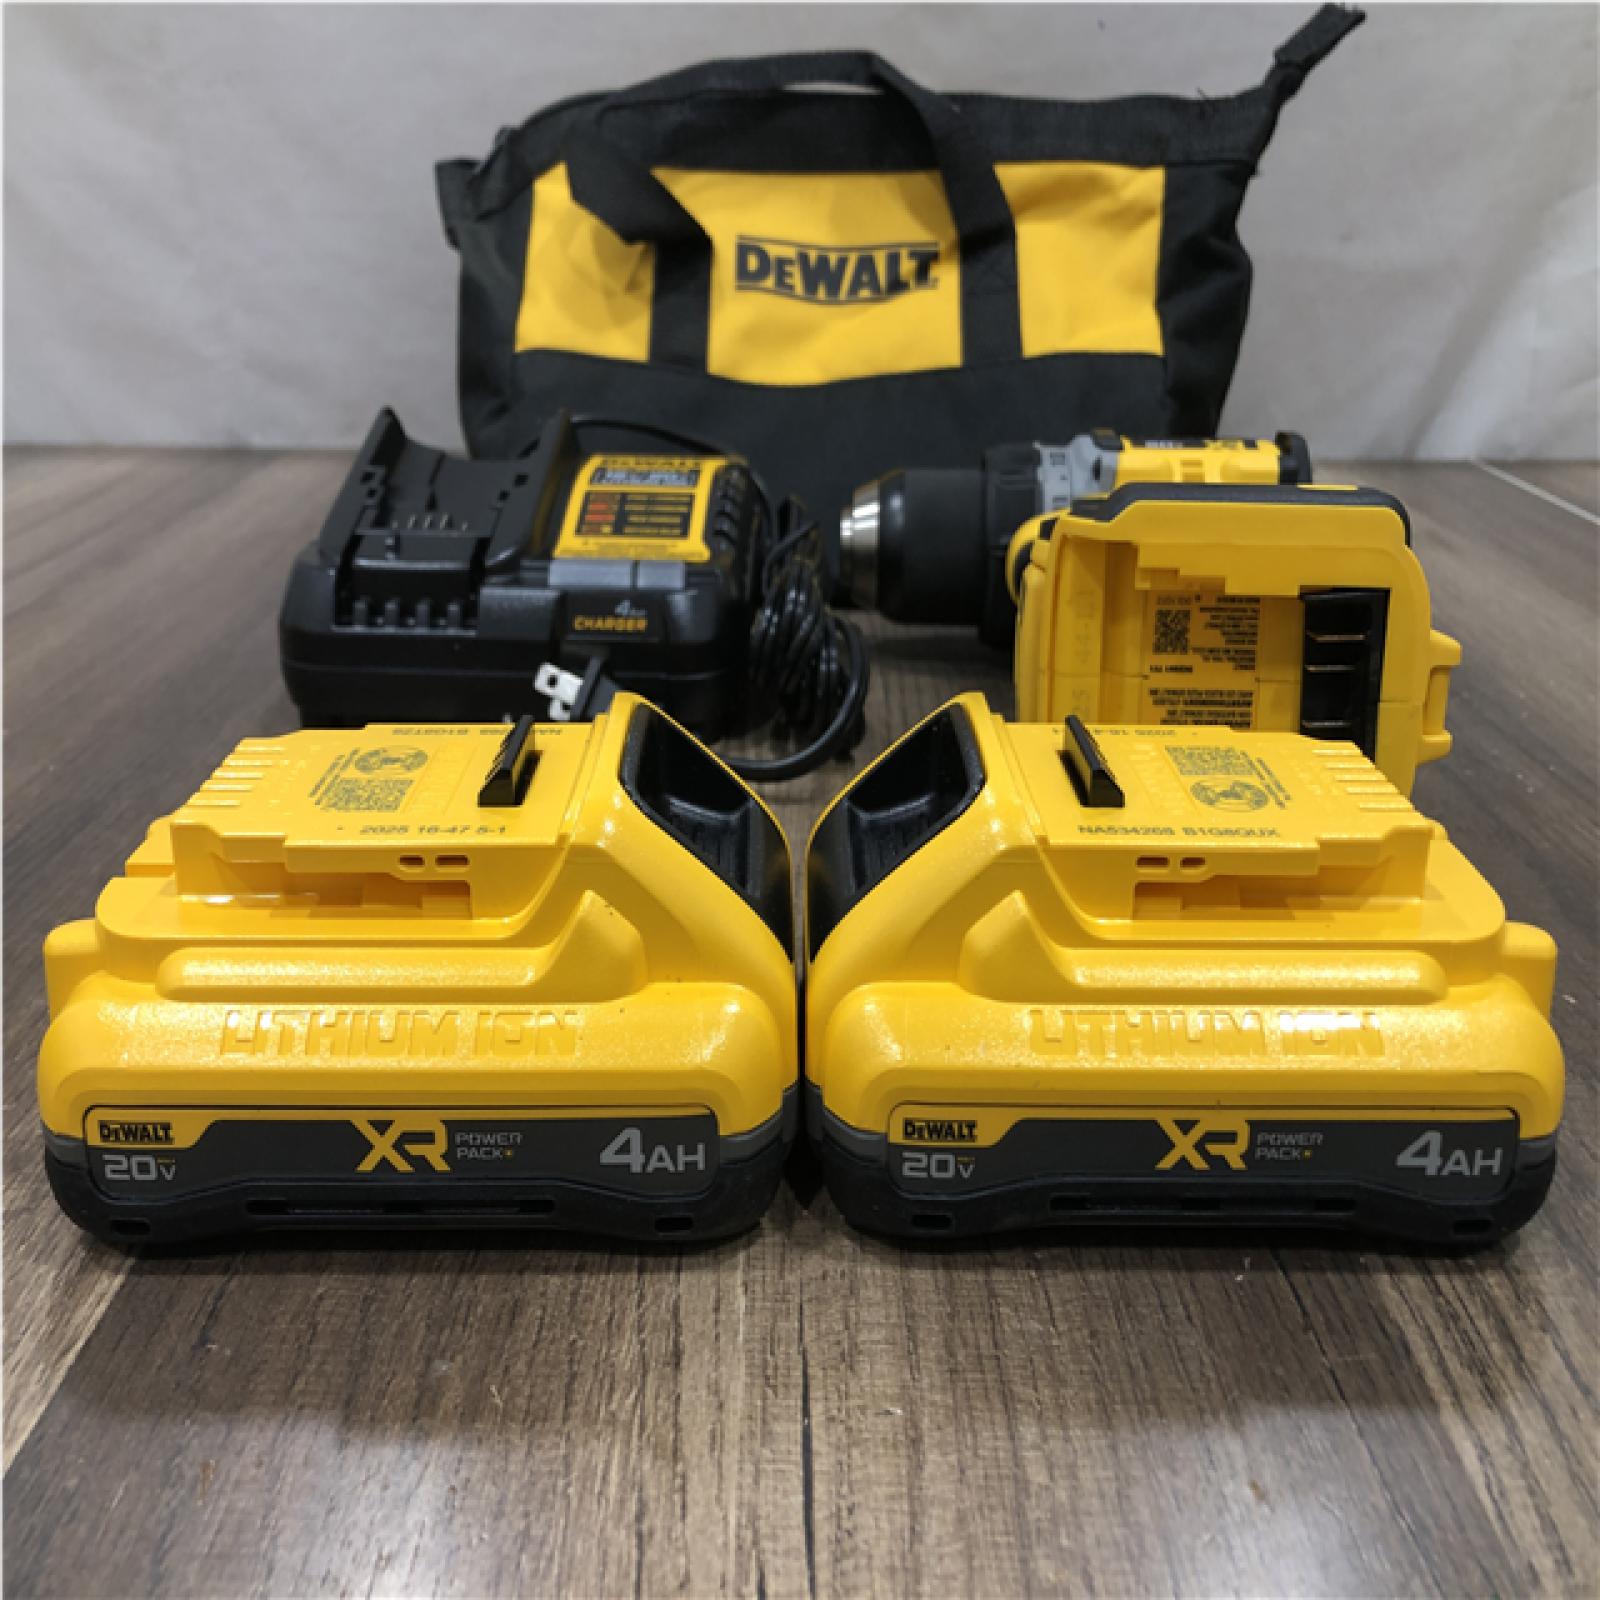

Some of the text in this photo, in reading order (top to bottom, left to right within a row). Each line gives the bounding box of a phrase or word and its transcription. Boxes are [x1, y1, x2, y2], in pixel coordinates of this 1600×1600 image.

[574, 615, 648, 632] CHARGER
[220, 1009, 580, 1056] LITHIUM ION
[1028, 1009, 1384, 1056] LITHIUM ION
[349, 1118, 451, 1173] XR
[455, 1131, 523, 1146] POWER
[1154, 1118, 1249, 1171] XR
[1256, 1131, 1323, 1146] POWER
